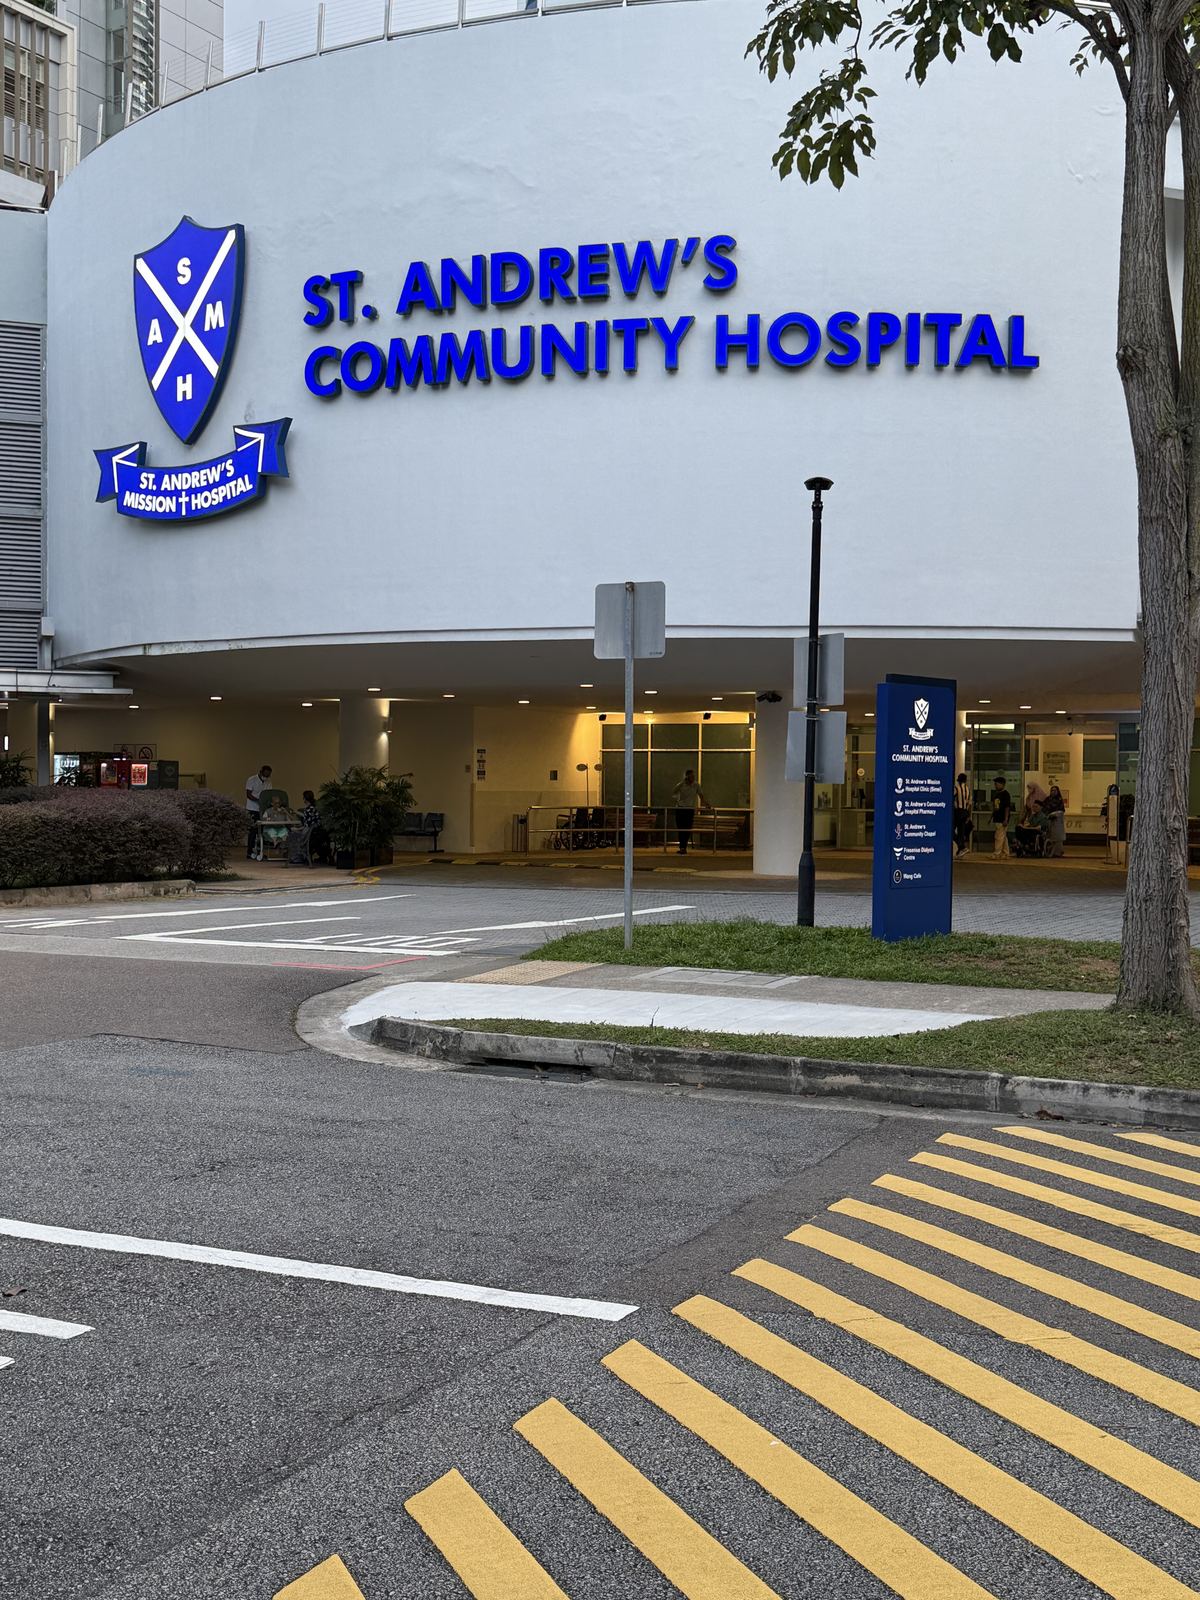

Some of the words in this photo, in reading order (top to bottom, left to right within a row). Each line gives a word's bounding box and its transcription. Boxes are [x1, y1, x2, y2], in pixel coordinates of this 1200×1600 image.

[176, 257, 192, 285] S
[303, 270, 377, 327] ST.
[396, 235, 739, 315] ANDREW'S
[204, 300, 225, 332] M
[147, 318, 163, 346] A
[304, 315, 694, 397] COMMUNITY
[715, 311, 1040, 370] HOSPITAL
[176, 373, 193, 402] H
[139, 472, 157, 491] ST.
[161, 459, 235, 491] ANDREW'S
[123, 490, 177, 513] MISSION
[190, 474, 254, 511] HOSPITAL
[891, 754, 924, 763] COMMUNITY
[924, 755, 949, 764] HOSPITAL
[903, 744, 911, 753] ST.
[912, 745, 939, 754] ANDREW'S
